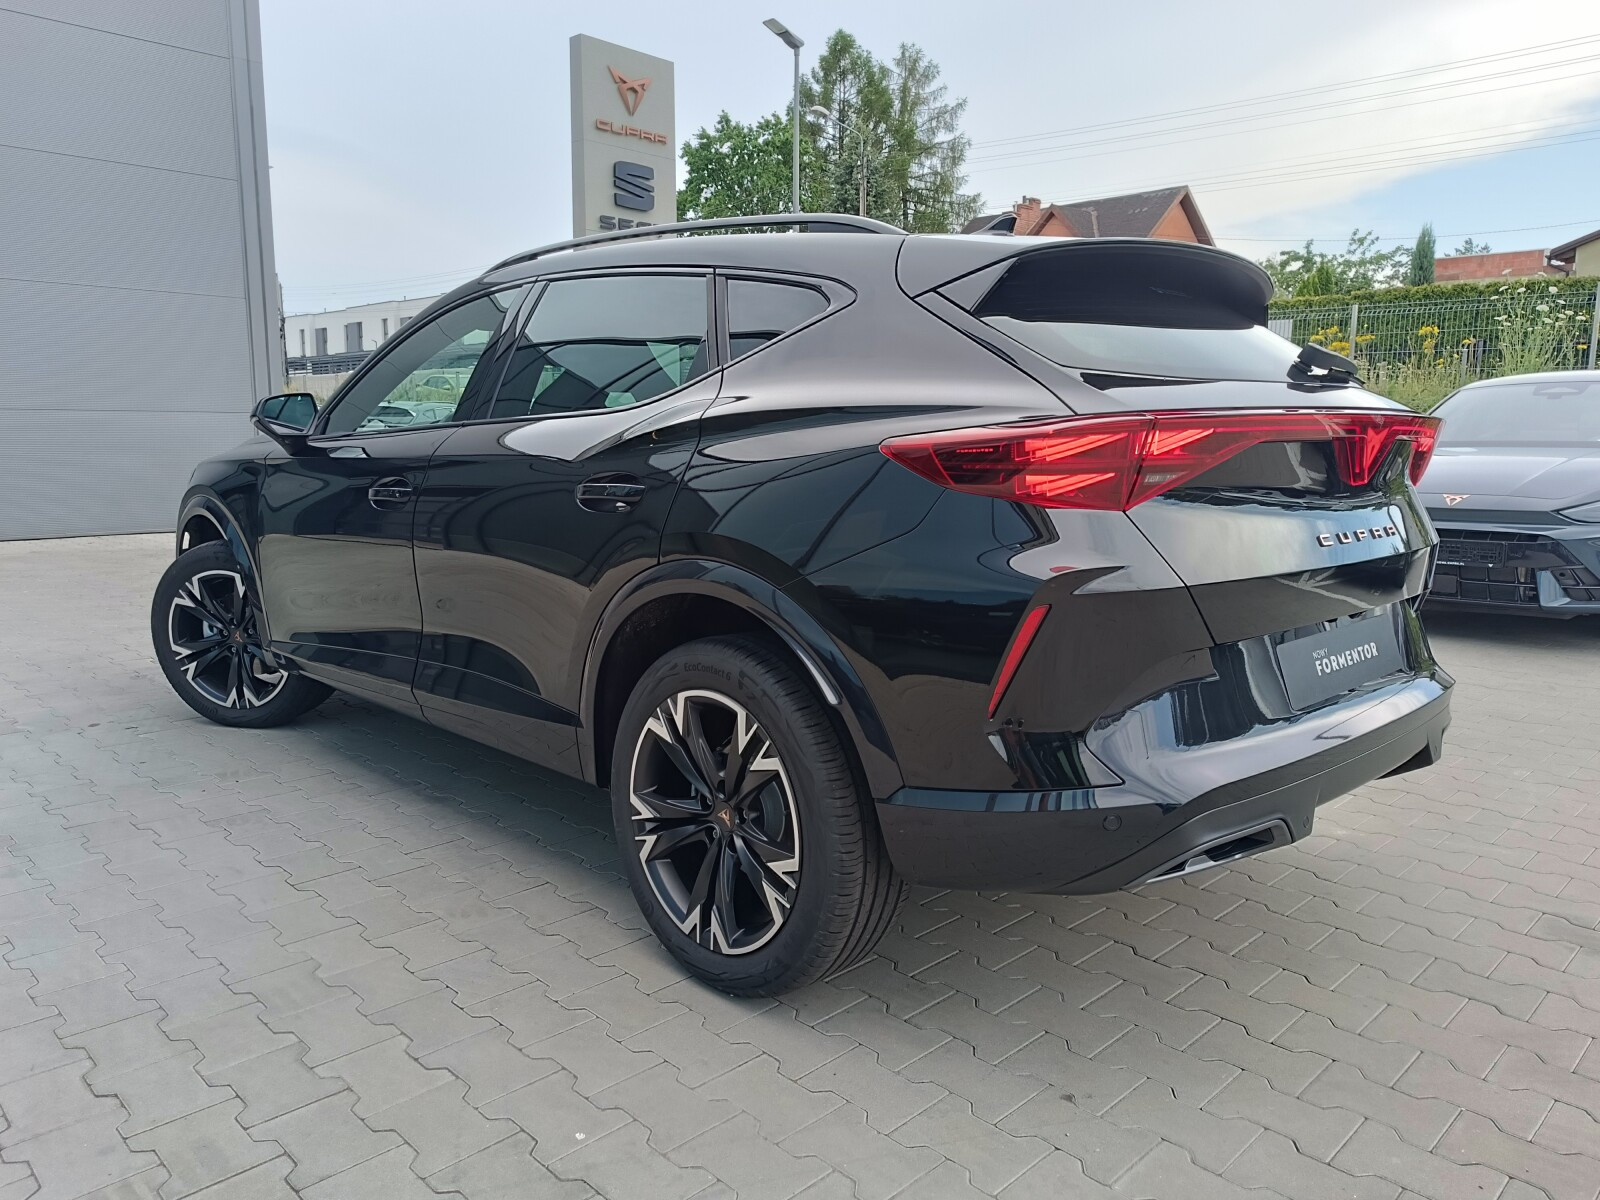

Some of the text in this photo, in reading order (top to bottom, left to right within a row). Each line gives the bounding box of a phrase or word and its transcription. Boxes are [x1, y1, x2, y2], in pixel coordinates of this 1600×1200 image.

[596, 119, 668, 145] CUPRA
[600, 215, 660, 230] SE
[1316, 525, 1397, 547] CUPRA
[684, 662, 726, 678] EcoContact
[1315, 642, 1379, 676] FORMENTOR
